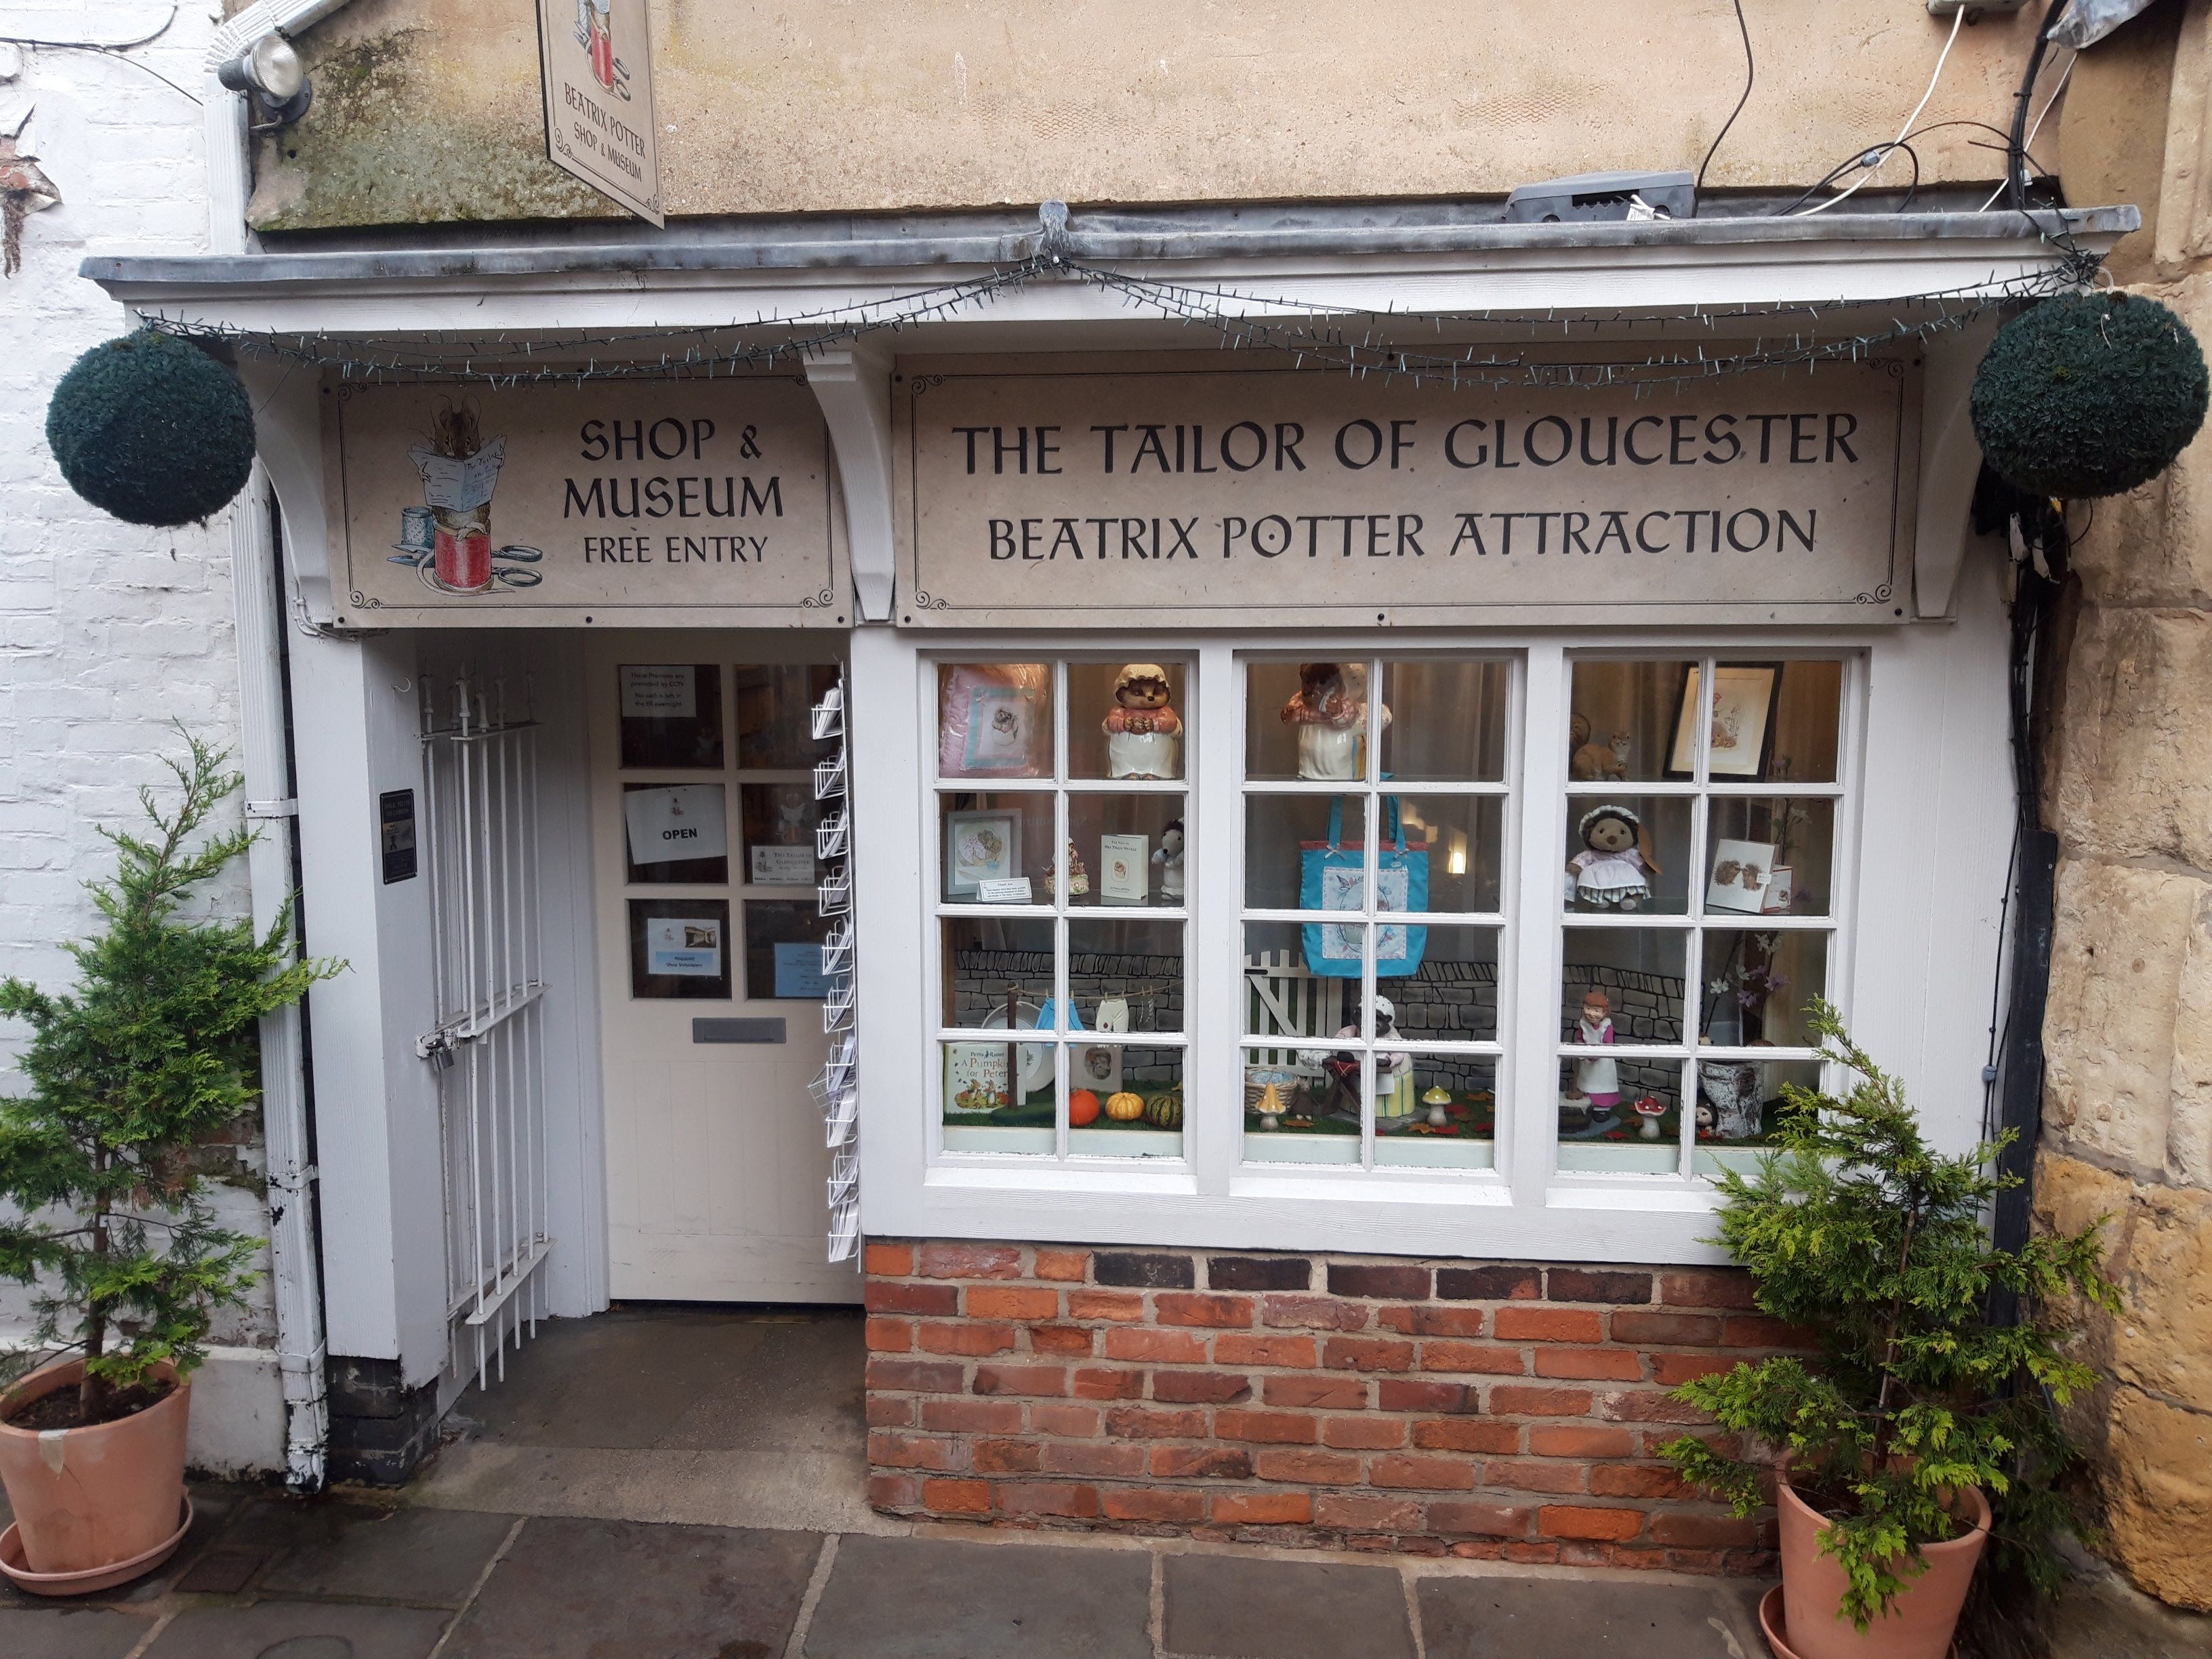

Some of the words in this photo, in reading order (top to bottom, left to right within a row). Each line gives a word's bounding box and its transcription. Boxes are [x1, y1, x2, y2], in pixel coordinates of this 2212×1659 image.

[564, 81, 607, 131] BEATRIX
[610, 115, 646, 160] POTTER
[574, 121, 598, 152] SHOP
[600, 143, 605, 157] &
[608, 144, 642, 183] MUSEUM
[581, 418, 715, 461] SHOP
[740, 425, 762, 459] &
[951, 426, 1063, 475] THE
[1090, 421, 1307, 474] TAILOR
[1335, 418, 1416, 470] OF
[1444, 413, 1859, 470] GLOUCESTER
[564, 476, 783, 519] MUSEUM
[584, 536, 653, 564] FREE
[665, 535, 768, 563] ENTRY
[989, 516, 1199, 560] BEATRIX
[1223, 513, 1425, 559] POTTER
[1450, 507, 1817, 556] ATTRACTION
[663, 828, 697, 840] OPEN
[967, 1069, 980, 1077] for
[983, 1069, 1008, 1078] Peter
